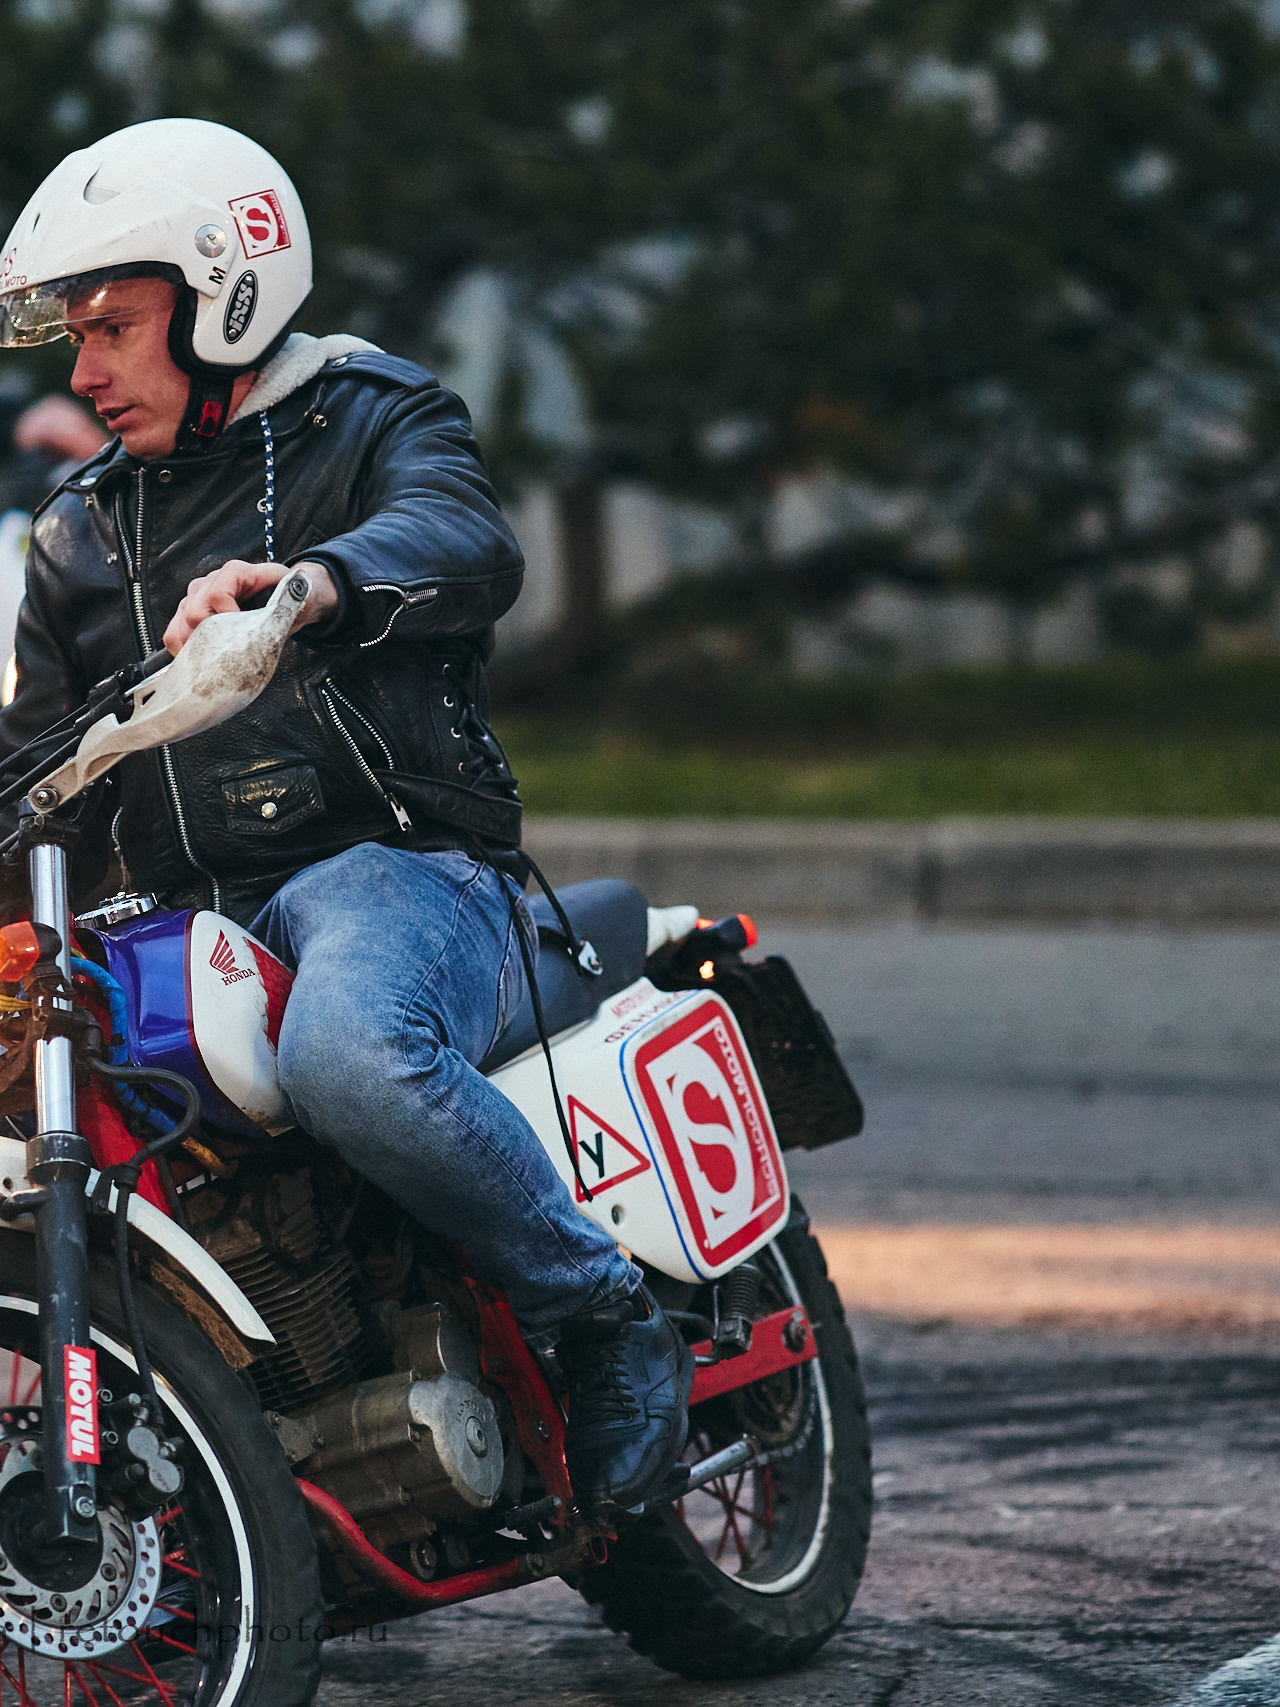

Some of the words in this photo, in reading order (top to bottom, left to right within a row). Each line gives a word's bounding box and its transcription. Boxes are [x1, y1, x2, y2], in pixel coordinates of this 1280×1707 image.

[208, 266, 226, 285] M
[221, 968, 256, 986] HONDA
[68, 1350, 95, 1456] MOTUL
